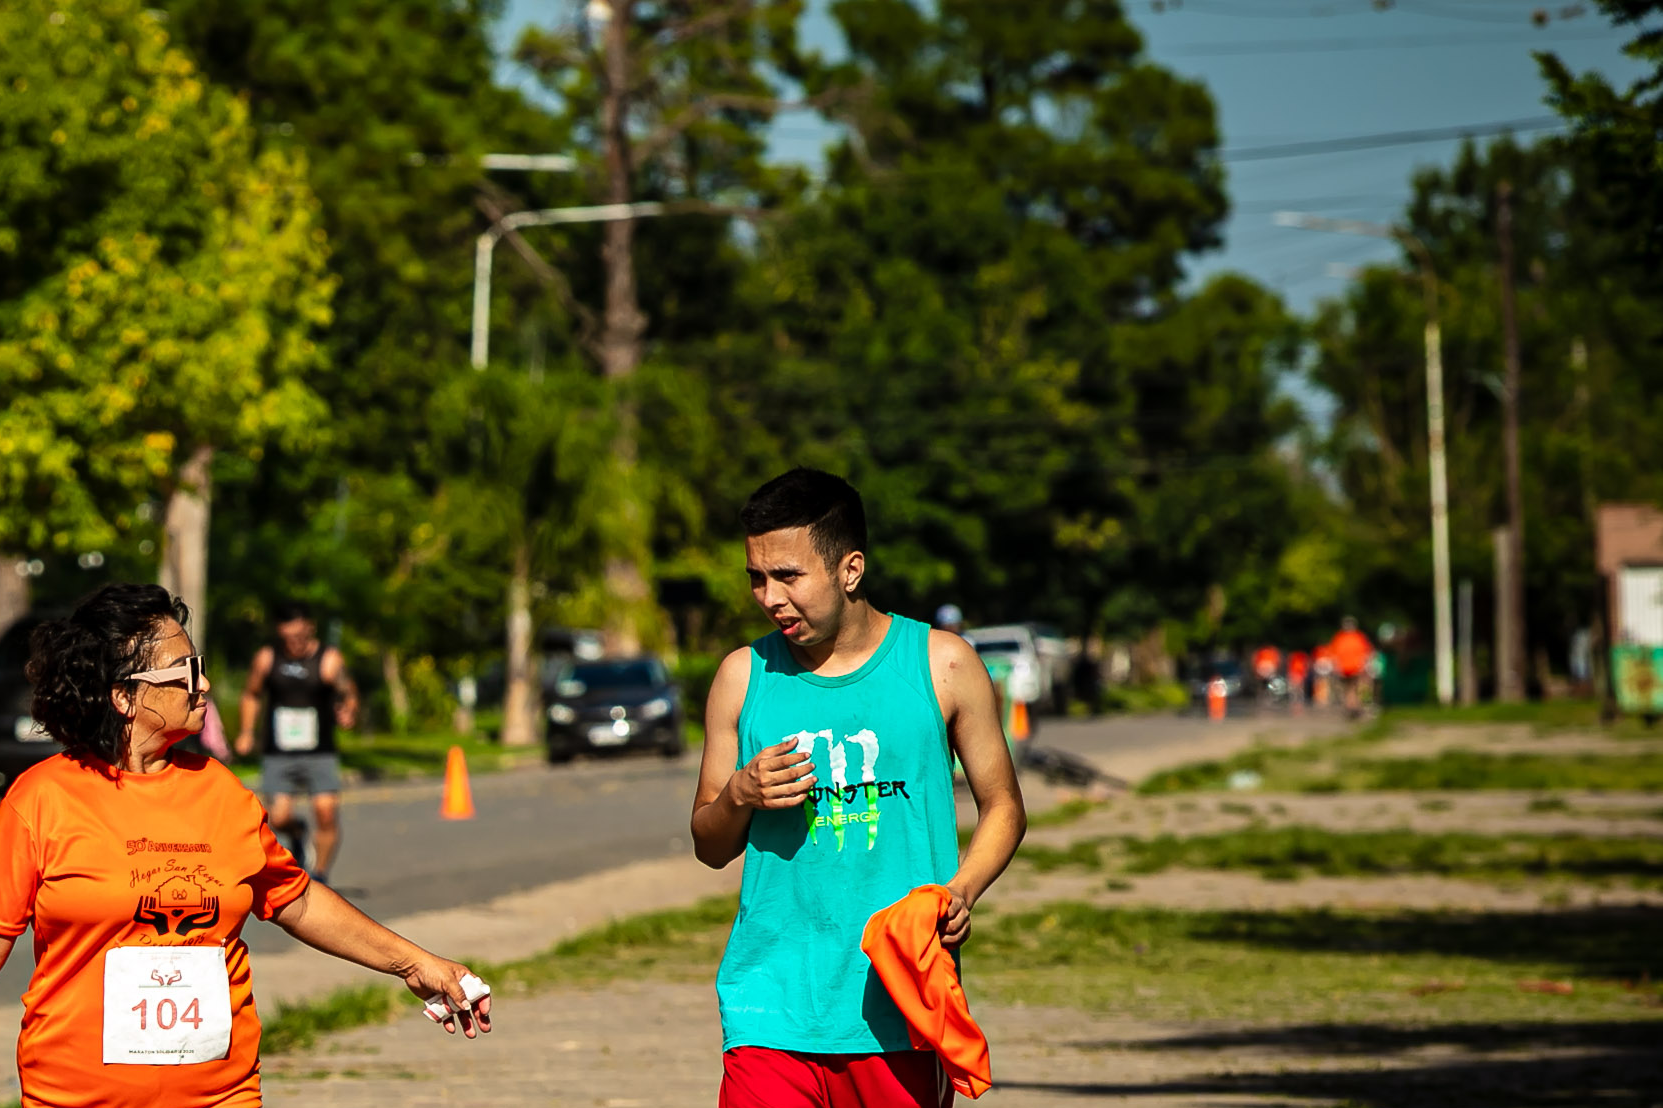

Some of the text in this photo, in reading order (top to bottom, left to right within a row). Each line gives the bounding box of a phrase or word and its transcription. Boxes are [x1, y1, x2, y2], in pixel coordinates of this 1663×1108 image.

[804, 781, 910, 805] ONSTER
[815, 811, 881, 827] ENERGY
[164, 859, 187, 872] San
[132, 998, 203, 1030] 104
